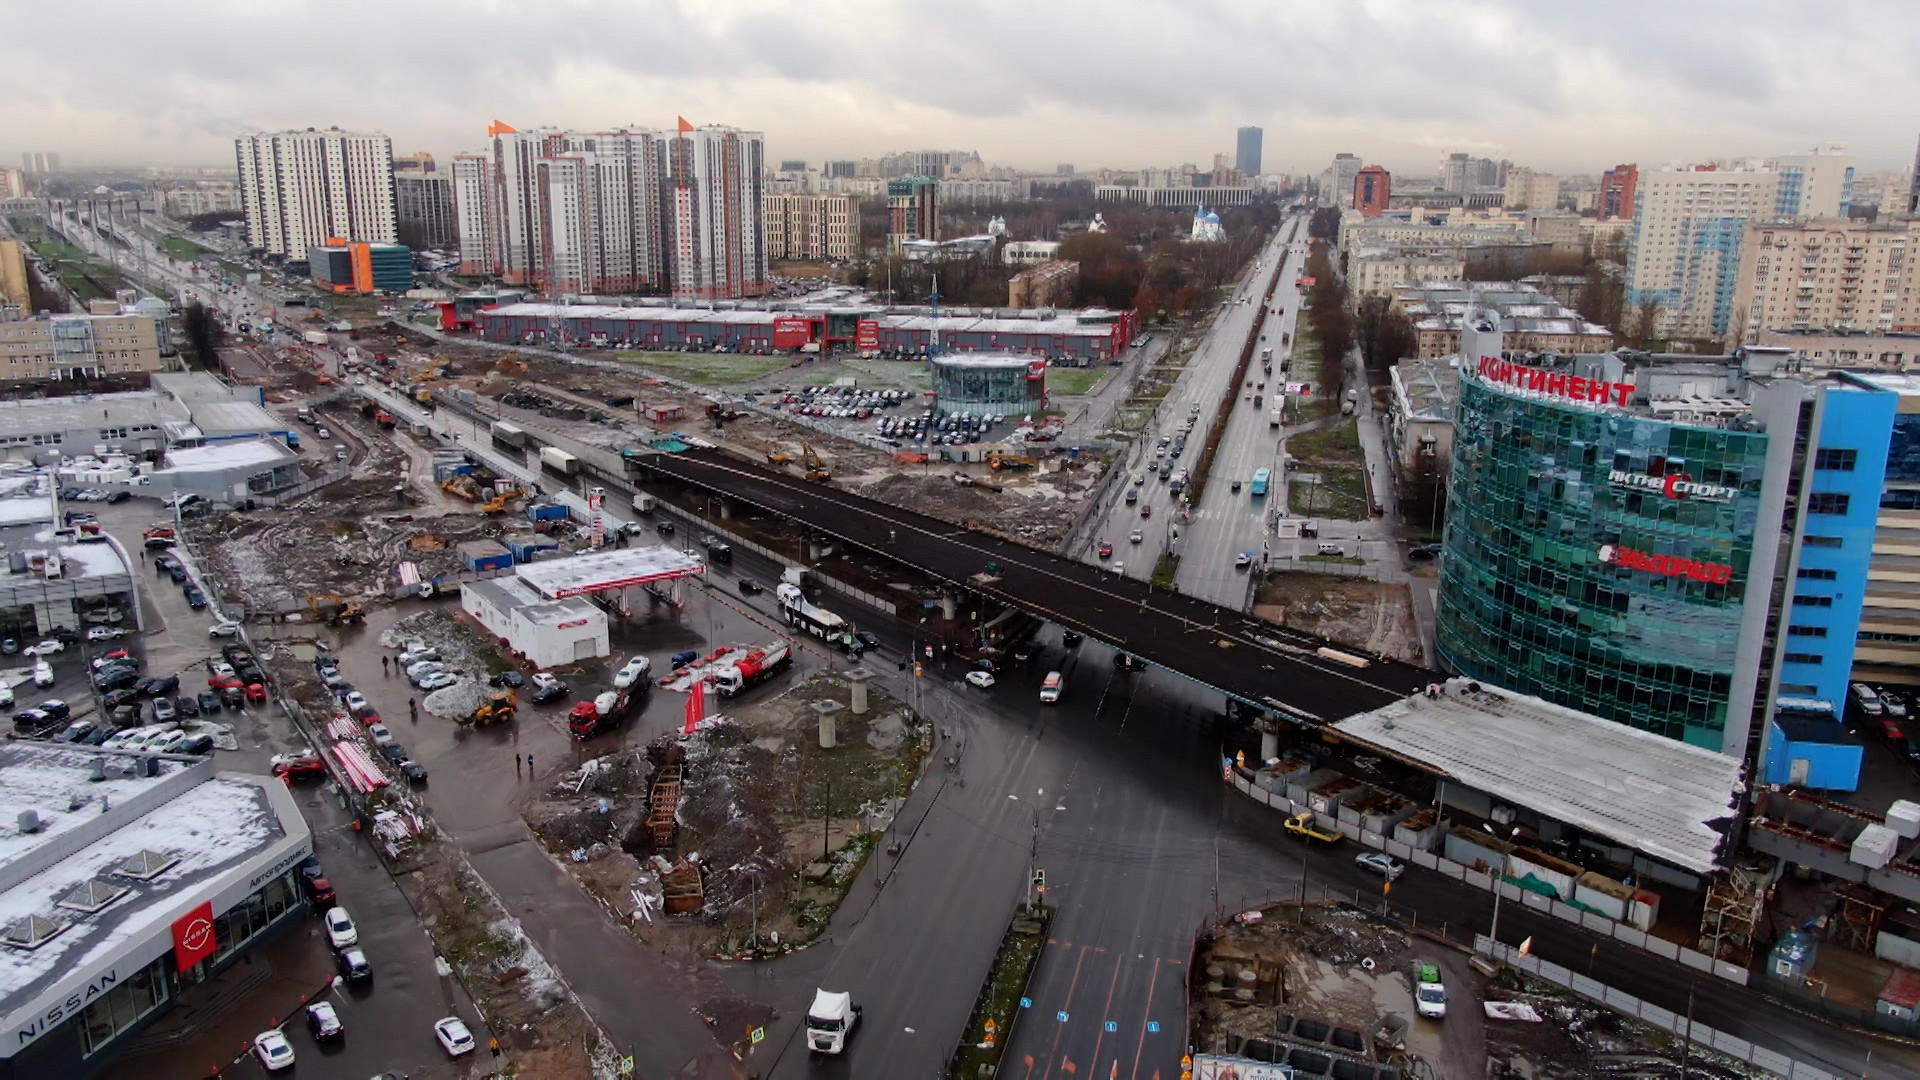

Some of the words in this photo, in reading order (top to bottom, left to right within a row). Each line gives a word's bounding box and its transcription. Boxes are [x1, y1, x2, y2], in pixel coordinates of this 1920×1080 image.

[1479, 355, 1635, 407] КОНТИНЕНТ
[1672, 481, 1738, 499] СПОРТ
[19, 970, 116, 1044] NISSAN
